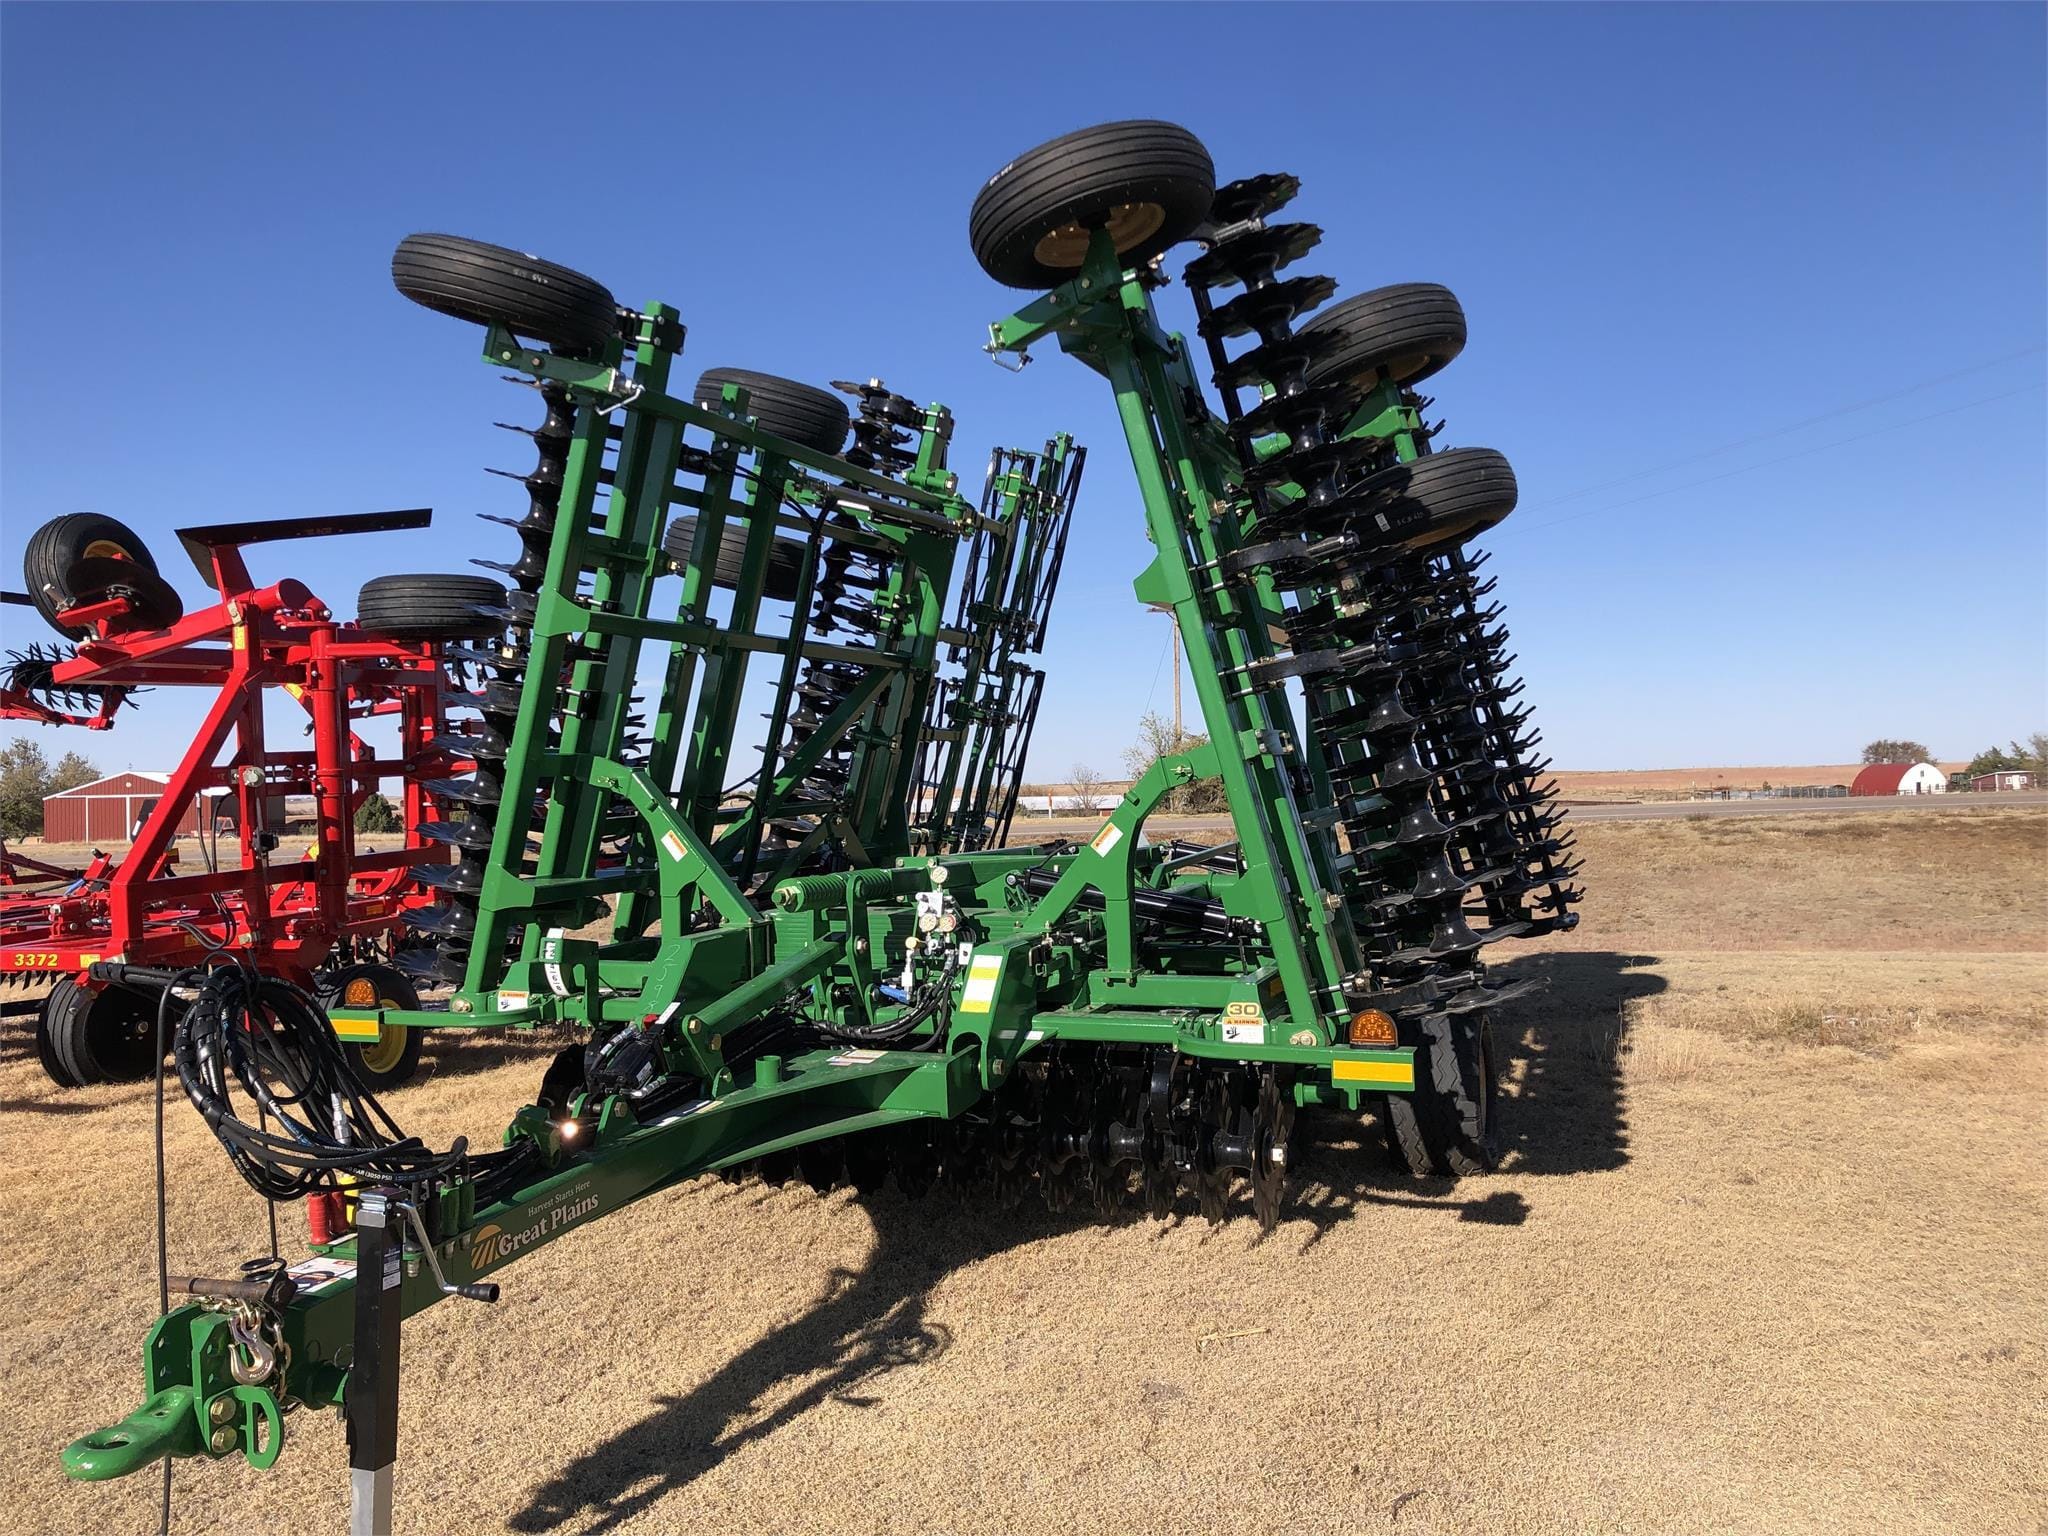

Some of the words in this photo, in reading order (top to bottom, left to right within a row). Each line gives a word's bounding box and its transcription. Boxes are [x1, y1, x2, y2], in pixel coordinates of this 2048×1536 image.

[14, 953, 58, 967] 3372
[1229, 1003, 1258, 1016] 30
[528, 1198, 554, 1217] Harvest
[555, 1188, 574, 1203] Starts
[575, 1181, 591, 1194] Here
[498, 1217, 549, 1256] Great
[550, 1193, 599, 1231] Plains
